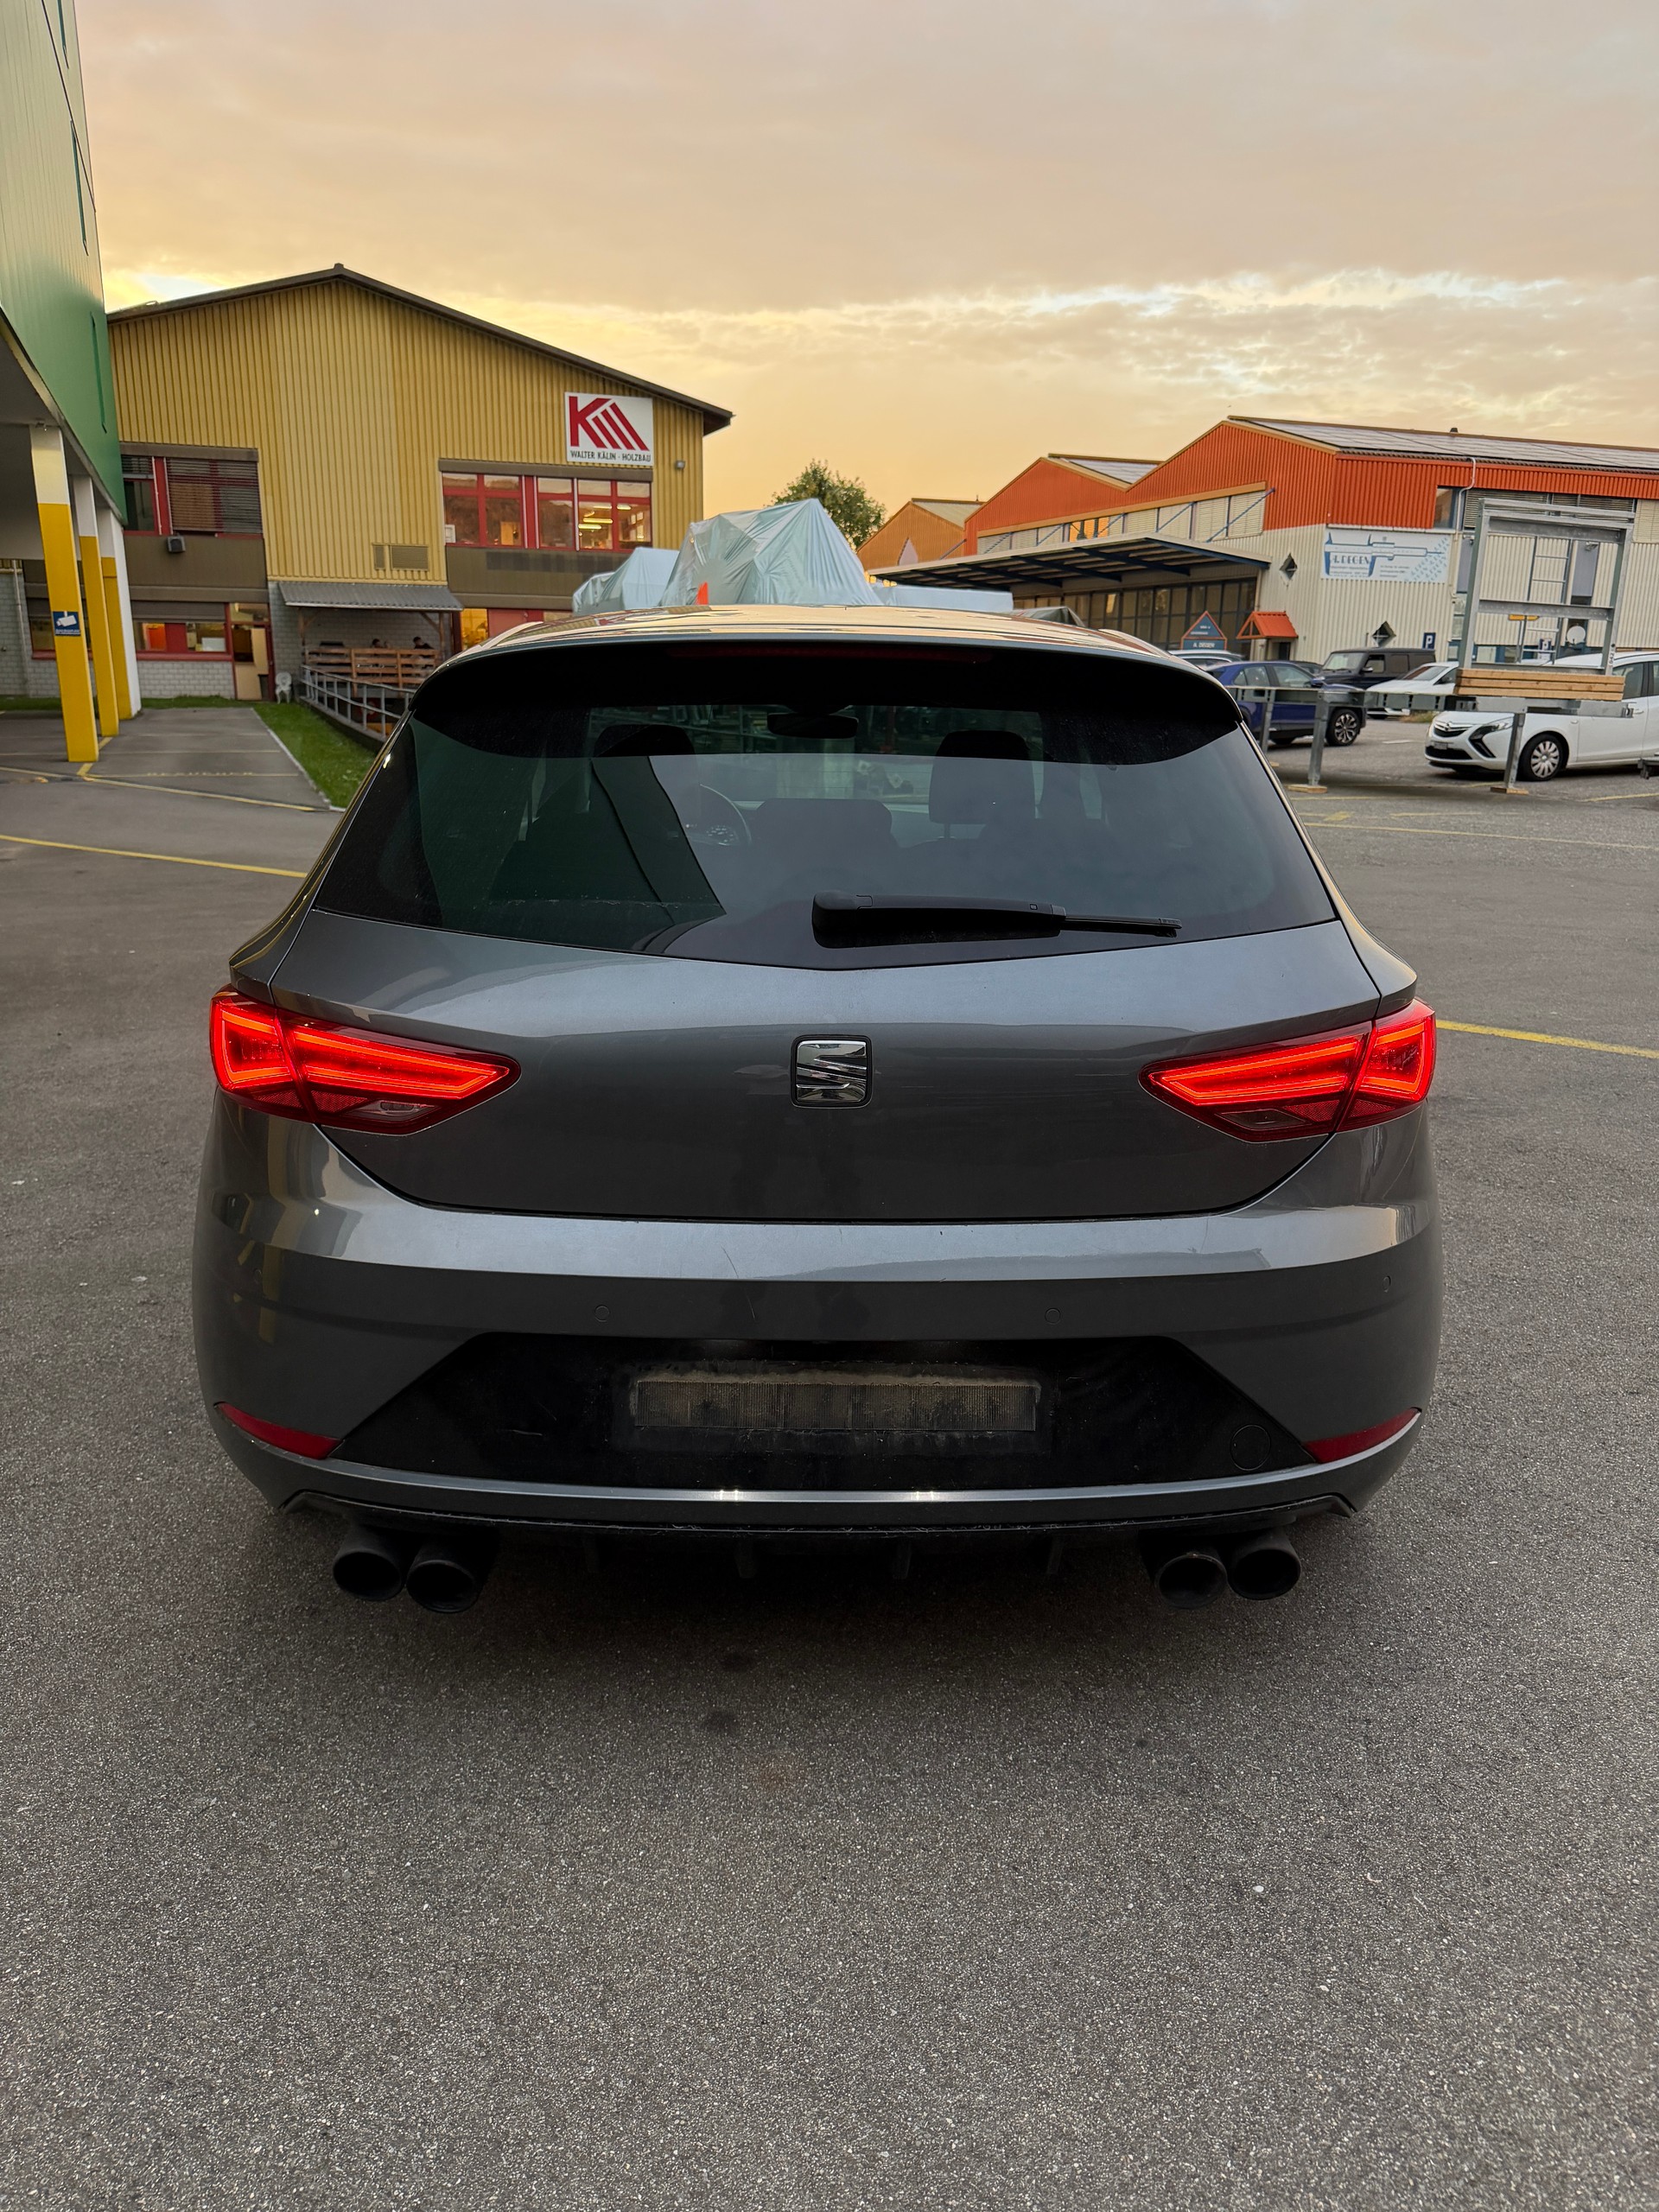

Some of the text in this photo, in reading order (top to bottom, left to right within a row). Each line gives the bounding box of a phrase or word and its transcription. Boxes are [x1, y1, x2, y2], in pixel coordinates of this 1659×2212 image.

[570, 450, 594, 459] WALTER
[597, 450, 616, 460] KÄLIN
[622, 453, 651, 462] HOLZBAU
[1426, 635, 1433, 648] P
